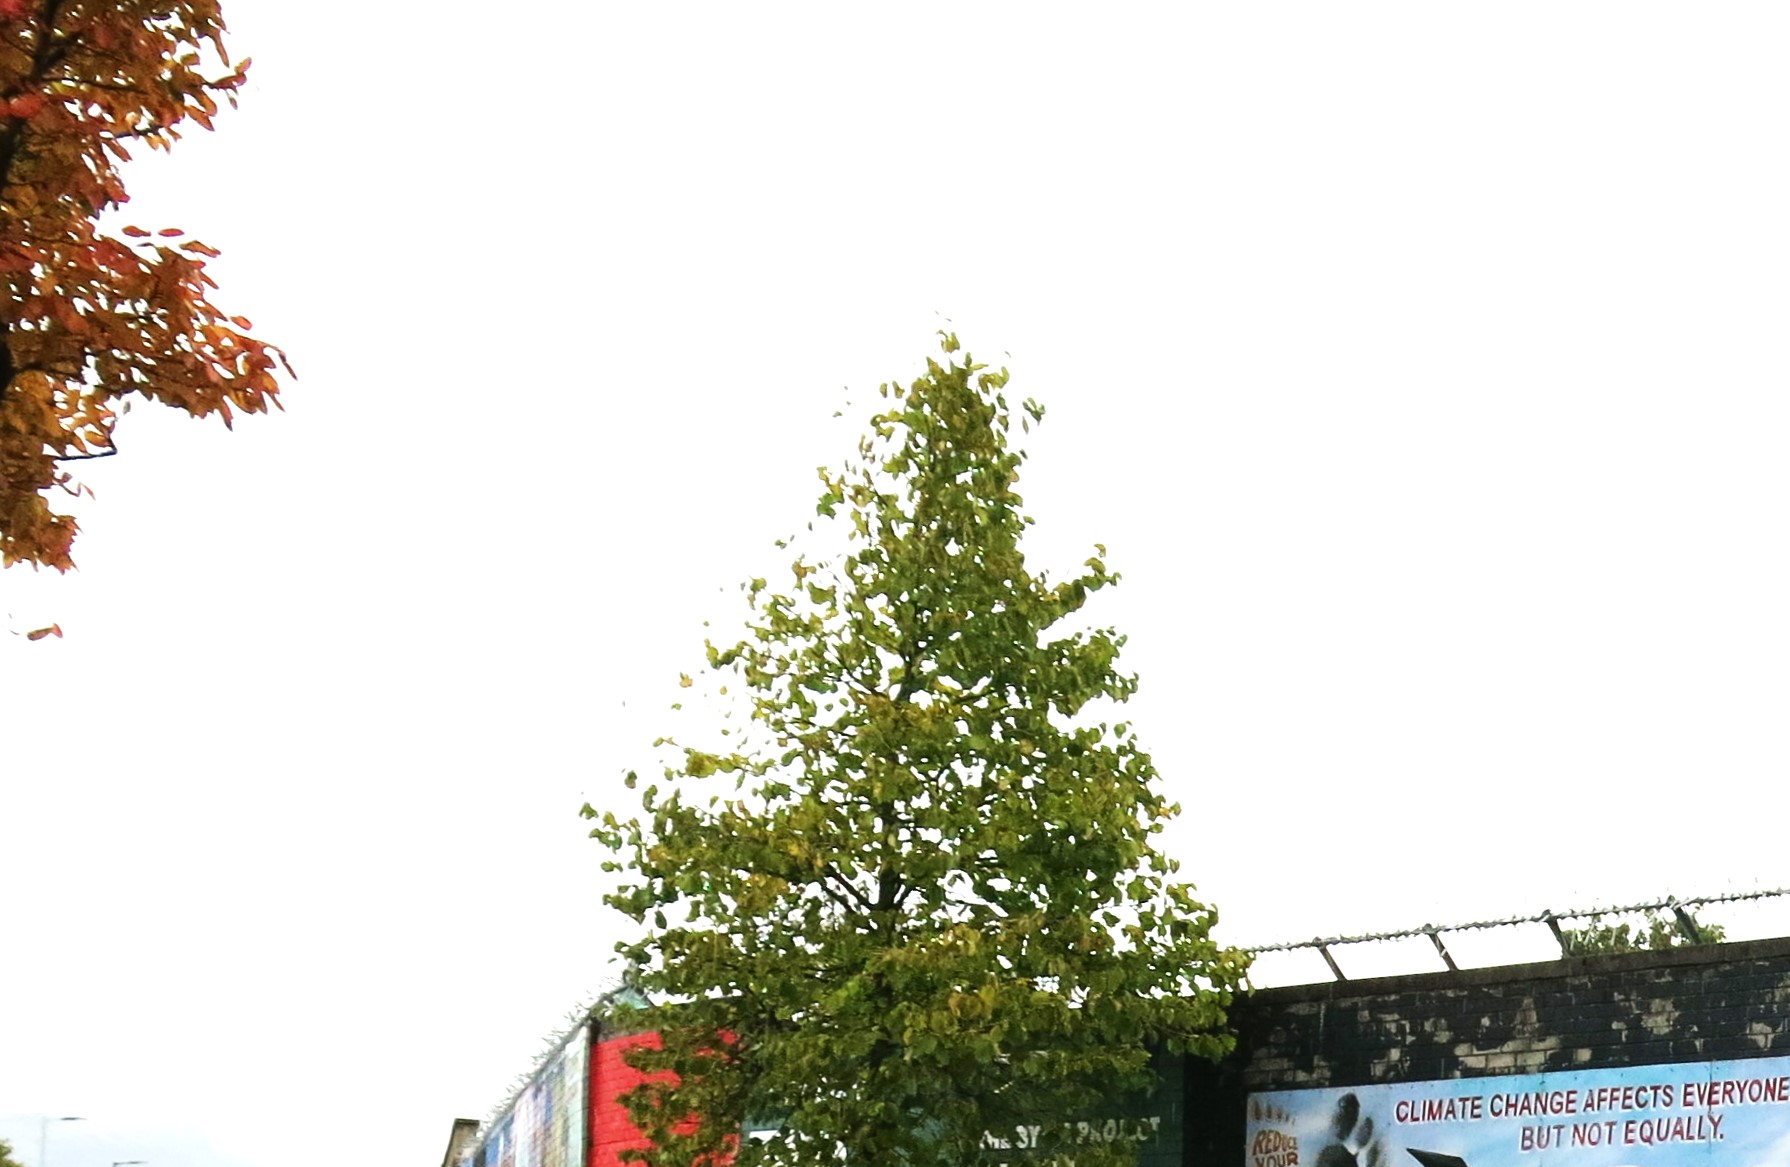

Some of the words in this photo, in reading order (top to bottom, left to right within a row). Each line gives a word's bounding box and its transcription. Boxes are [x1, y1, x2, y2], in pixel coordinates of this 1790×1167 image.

[1395, 1095, 1483, 1123] CLIMATE
[1489, 1090, 1578, 1118] CHANGE
[1583, 1084, 1674, 1113] AFFECTS
[1252, 1129, 1298, 1156] REDUCE
[1519, 1124, 1566, 1152] BUT
[1572, 1120, 1618, 1147] NOT
[1623, 1114, 1725, 1146] EQUALLY.
